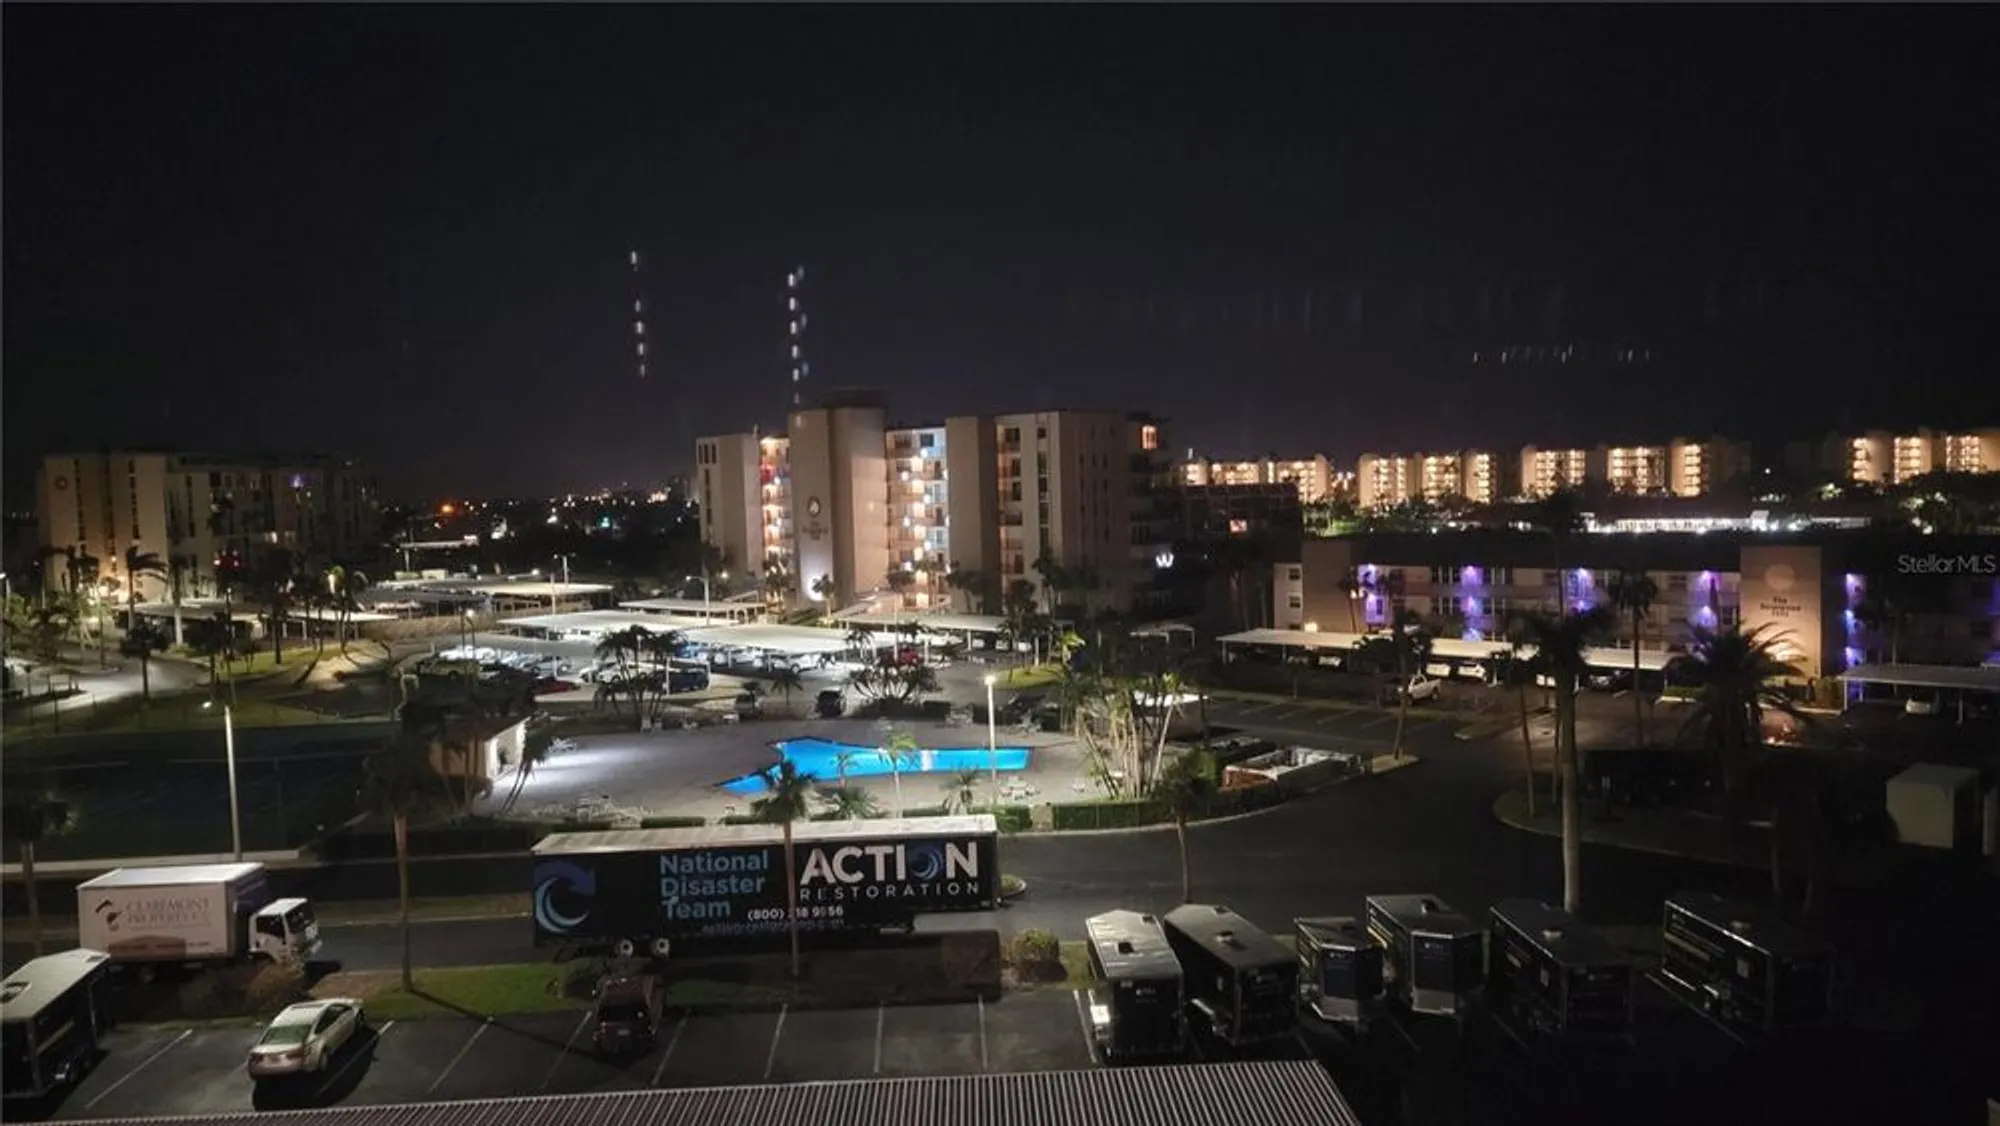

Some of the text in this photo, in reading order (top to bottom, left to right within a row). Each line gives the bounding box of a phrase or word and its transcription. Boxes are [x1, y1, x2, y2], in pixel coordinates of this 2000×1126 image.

[660, 849, 769, 875] National
[661, 875, 766, 898] Disaster
[800, 883, 980, 901] RESTORATION
[661, 898, 731, 920] Team
[747, 908, 785, 921] (800)
